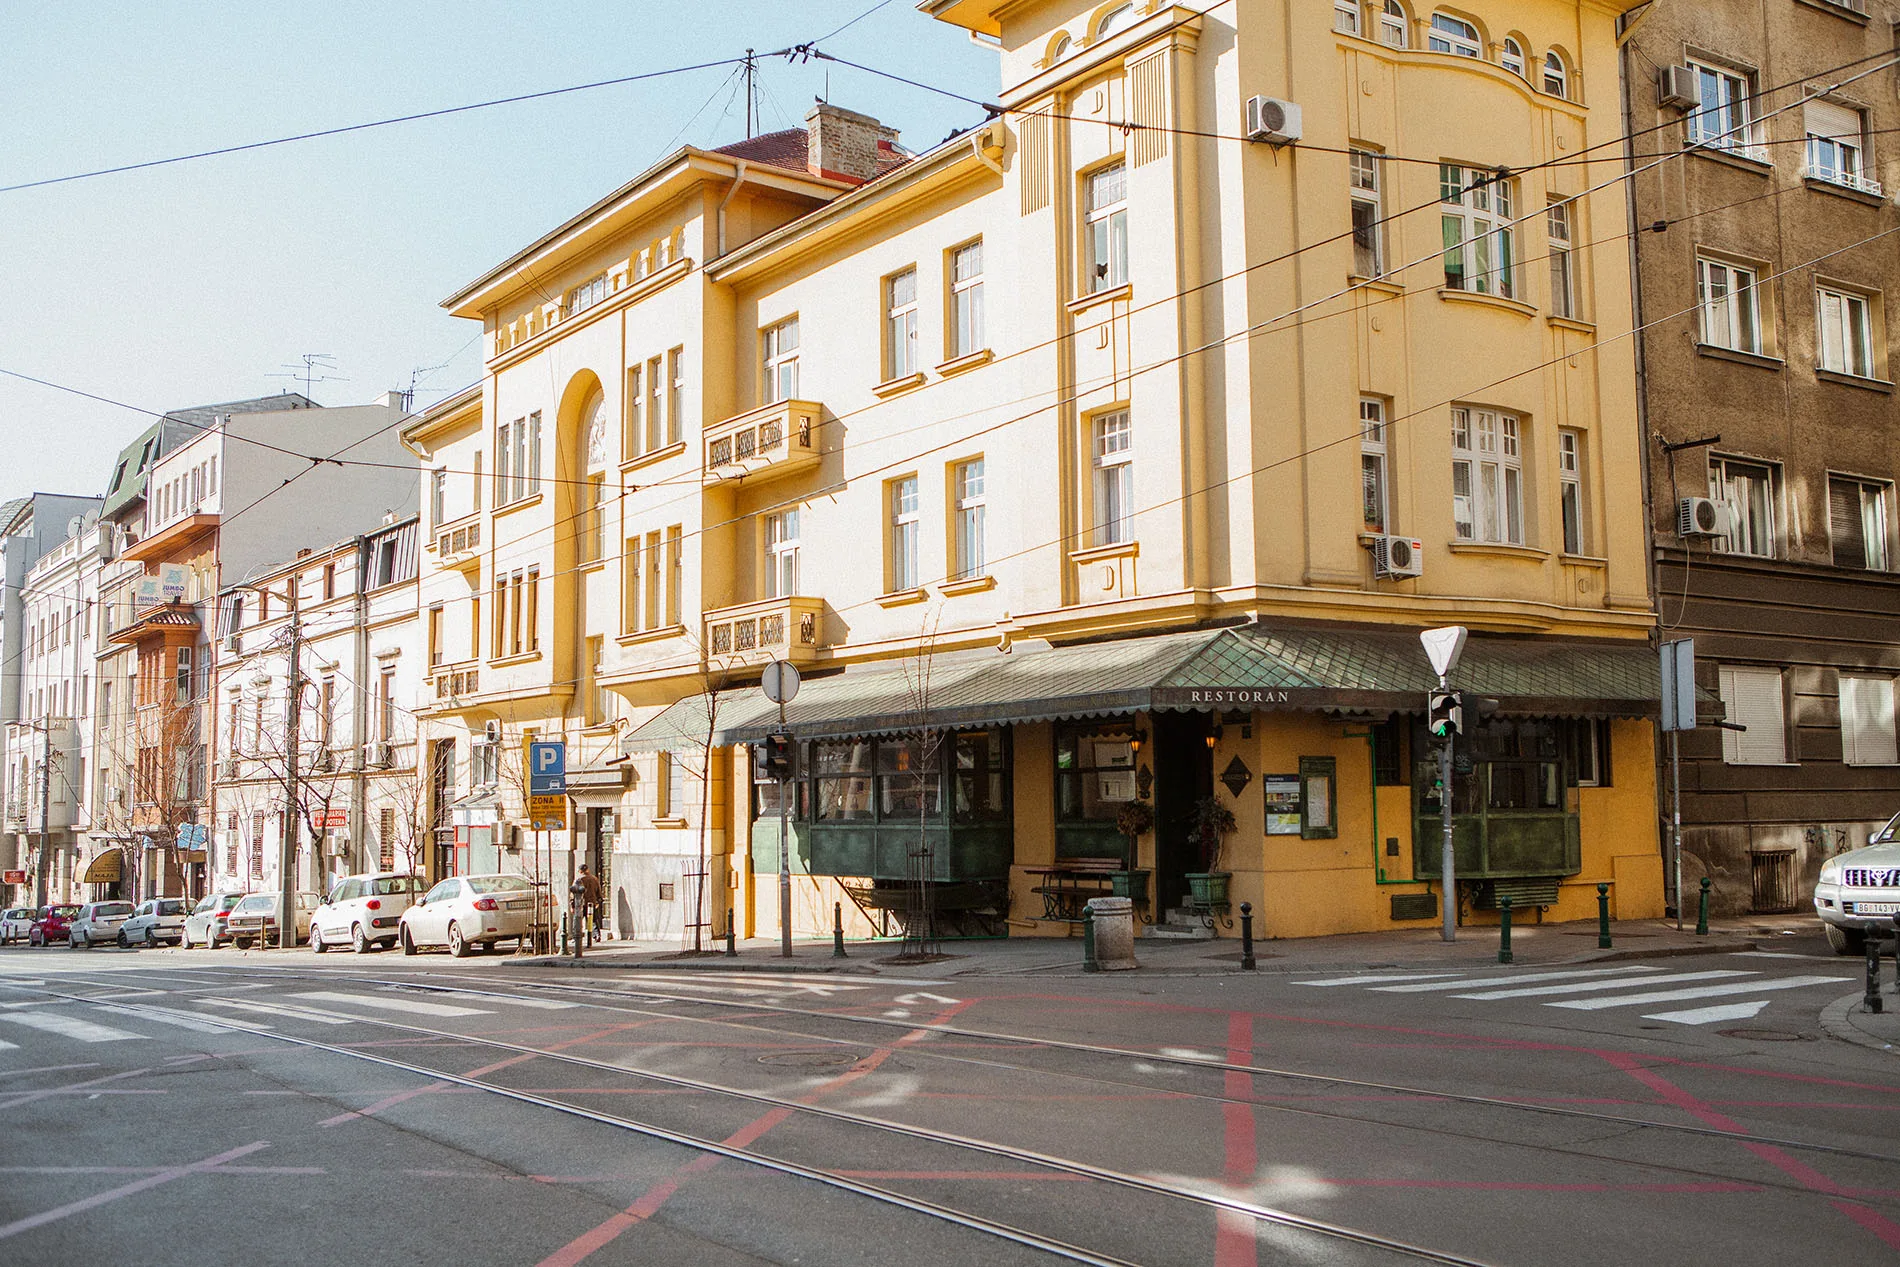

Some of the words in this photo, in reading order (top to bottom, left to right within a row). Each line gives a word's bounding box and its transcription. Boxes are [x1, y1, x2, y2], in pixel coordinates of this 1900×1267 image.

[1191, 691, 1288, 702] RESTORAN
[540, 748, 557, 771] P
[324, 818, 345, 826] POTEKA
